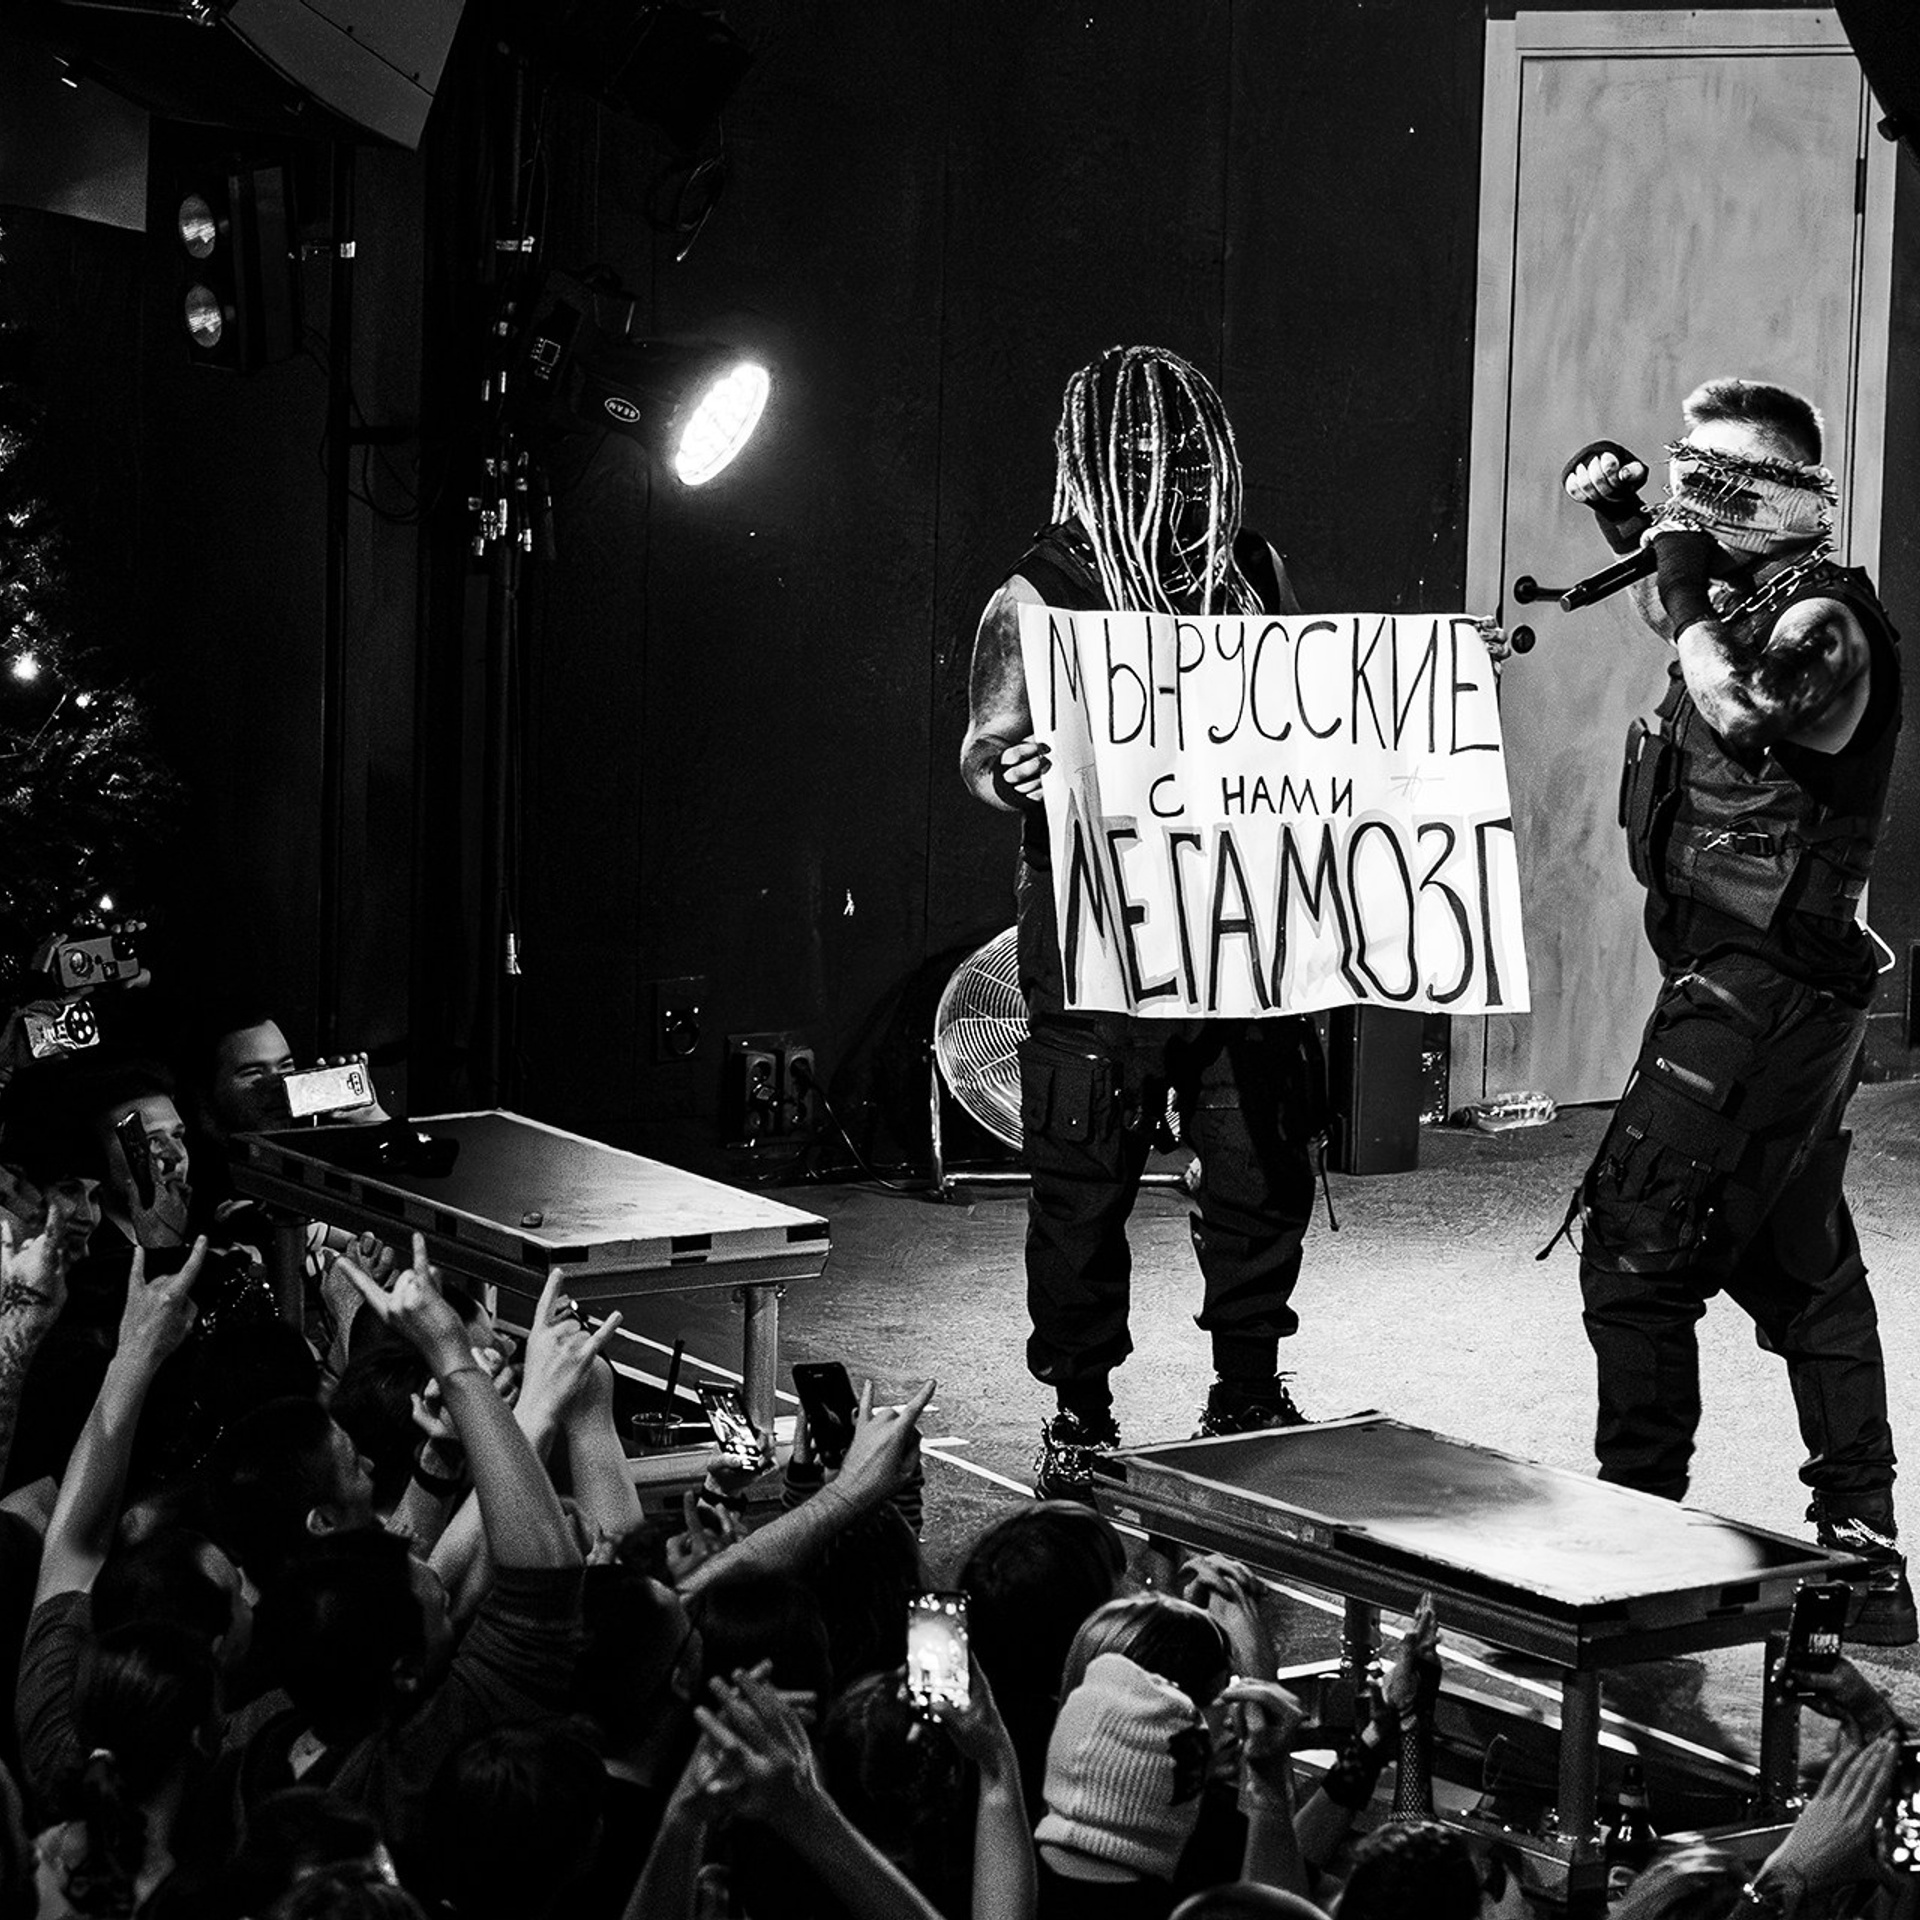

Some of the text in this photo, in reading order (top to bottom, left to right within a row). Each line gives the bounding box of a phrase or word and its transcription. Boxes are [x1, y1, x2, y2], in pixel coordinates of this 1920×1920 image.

[1149, 773, 1353, 818] С НАМИ
[1063, 812, 1514, 1012] МЕГАМОЗГ
